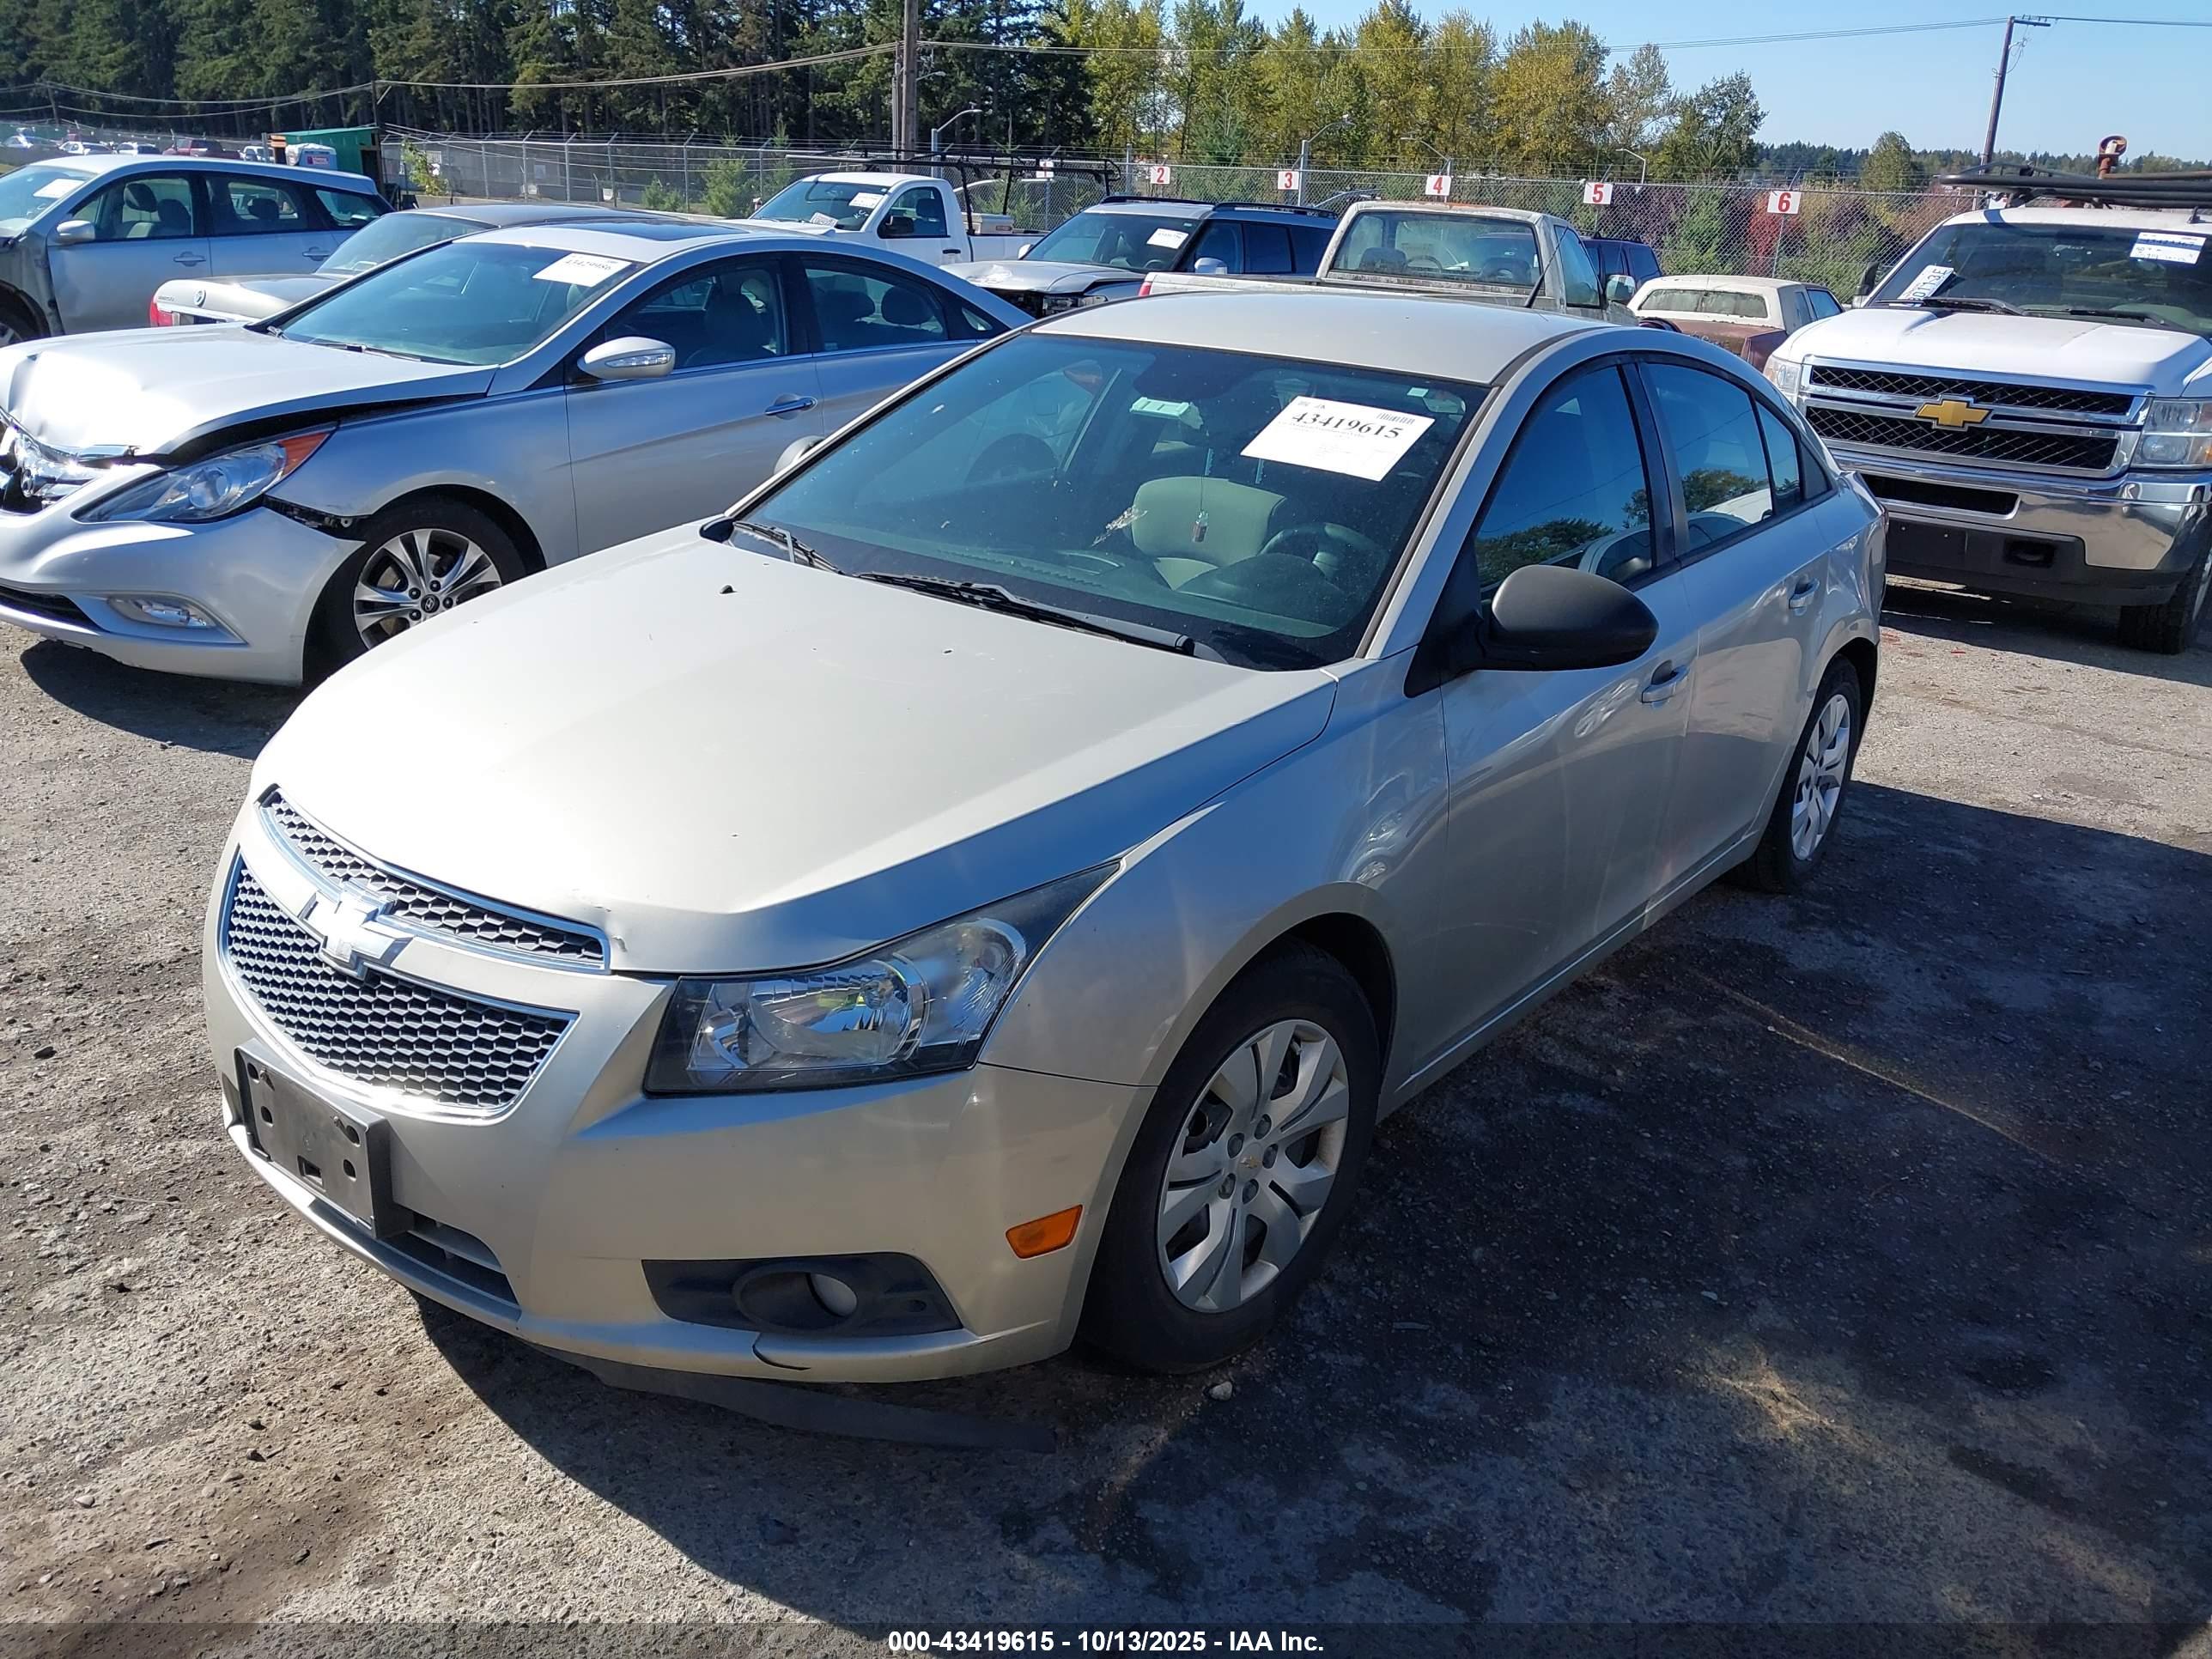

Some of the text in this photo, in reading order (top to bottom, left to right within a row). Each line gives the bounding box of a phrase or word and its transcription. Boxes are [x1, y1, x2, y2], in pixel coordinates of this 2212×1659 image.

[1157, 167, 1164, 183] 2
[1285, 173, 1292, 188] 3
[1433, 177, 1443, 193] 4
[1593, 184, 1604, 204] 5
[1778, 192, 1791, 213] 6
[1292, 412, 1403, 439] 43419615
